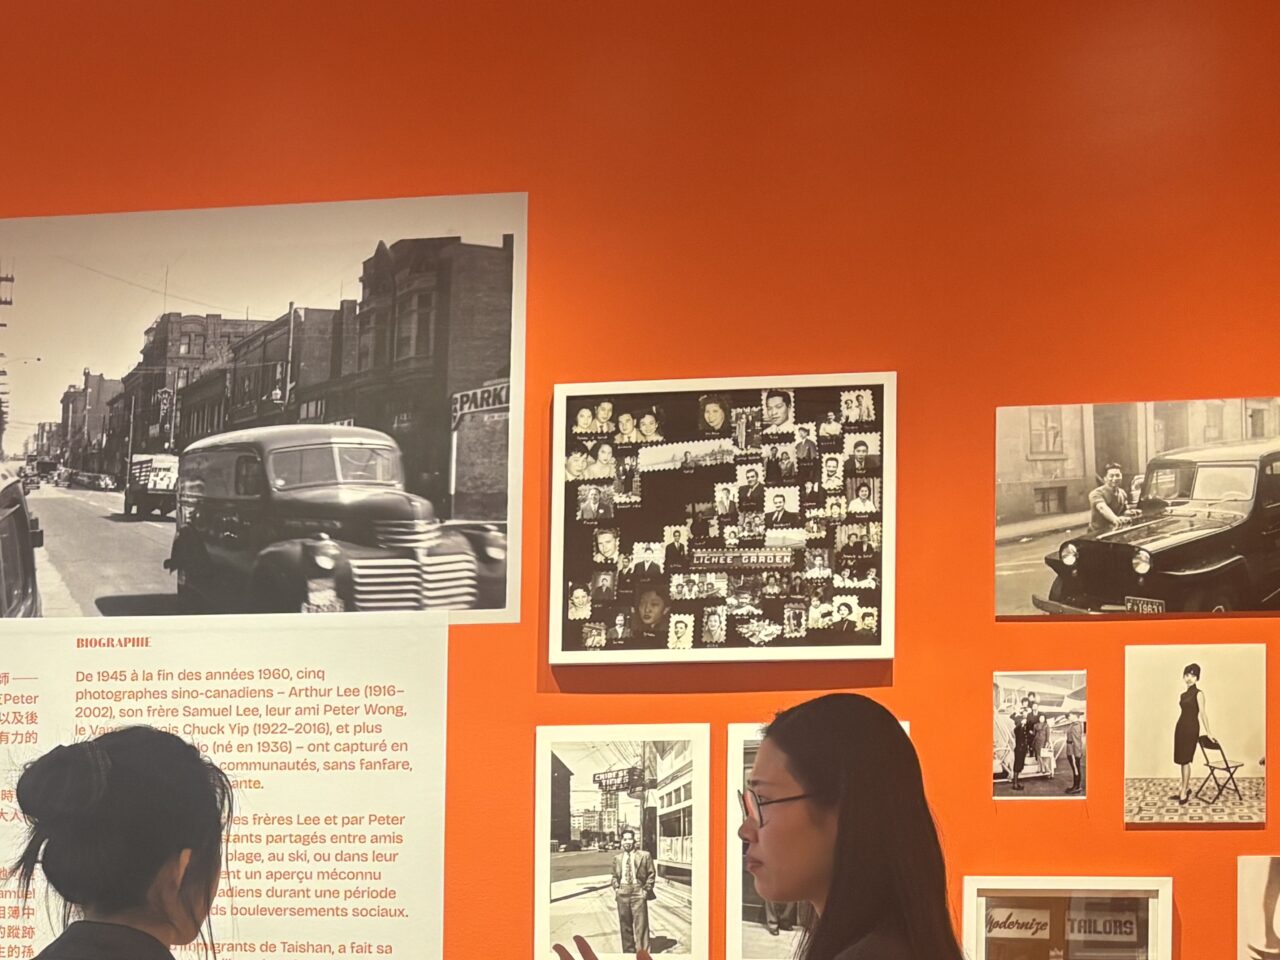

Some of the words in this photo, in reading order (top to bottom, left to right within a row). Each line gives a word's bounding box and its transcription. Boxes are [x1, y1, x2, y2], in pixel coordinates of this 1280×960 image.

[75, 636, 153, 649] BIOGRAPHIE
[75, 670, 94, 683] De
[96, 670, 128, 682] 1945
[130, 669, 139, 682] à
[142, 669, 154, 682] la
[157, 669, 174, 682] fin
[177, 668, 202, 681] des
[205, 667, 255, 681] années
[258, 667, 293, 682] 1960,
[296, 667, 325, 682] cinq
[75, 687, 168, 703] photographes
[171, 686, 274, 700] sino-canadiens
[288, 685, 333, 698] Arthur
[336, 685, 361, 698] Lee
[118, 708, 144, 718] son
[146, 704, 180, 718] frère
[182, 704, 233, 718] Samuel
[235, 704, 262, 719] Lee,
[265, 704, 292, 717] leur
[294, 703, 320, 717] ami
[323, 703, 361, 716] Peter
[363, 703, 408, 718] Wong,
[74, 723, 86, 736] le
[182, 722, 226, 736] Chuck
[228, 722, 250, 737] Yip
[335, 722, 350, 734] et
[353, 721, 383, 737] plus
[212, 740, 233, 755] (né
[236, 743, 254, 753] en
[257, 740, 293, 755] 1936)
[306, 741, 331, 753] ont
[333, 740, 388, 755] capturé
[390, 741, 409, 753] en
[322, 760, 356, 771] sans
[359, 757, 413, 772] fanfare,
[252, 813, 294, 826] frères
[296, 813, 321, 826] Lee
[323, 814, 338, 826] et
[341, 815, 365, 828] par
[368, 813, 406, 826] Peter
[265, 831, 327, 847] partagés
[329, 832, 367, 844] entre
[369, 831, 404, 844] amis
[267, 852, 285, 862] au
[287, 849, 310, 864] ski,
[313, 852, 331, 863] ou
[334, 849, 369, 863] dans
[371, 850, 399, 863] leur
[244, 870, 262, 881] un
[265, 870, 313, 884] aperçu
[316, 867, 382, 881] méconnu
[265, 886, 312, 899] durant
[314, 888, 340, 899] une
[343, 886, 397, 902] période
[230, 903, 349, 918] bouleversements
[351, 905, 409, 918] sociaux.
[1067, 918, 1134, 936] TAILORS
[259, 940, 277, 953] de
[279, 940, 335, 956] Taishan,
[337, 944, 347, 954] a
[350, 941, 373, 955] fait
[376, 944, 393, 955] sa
